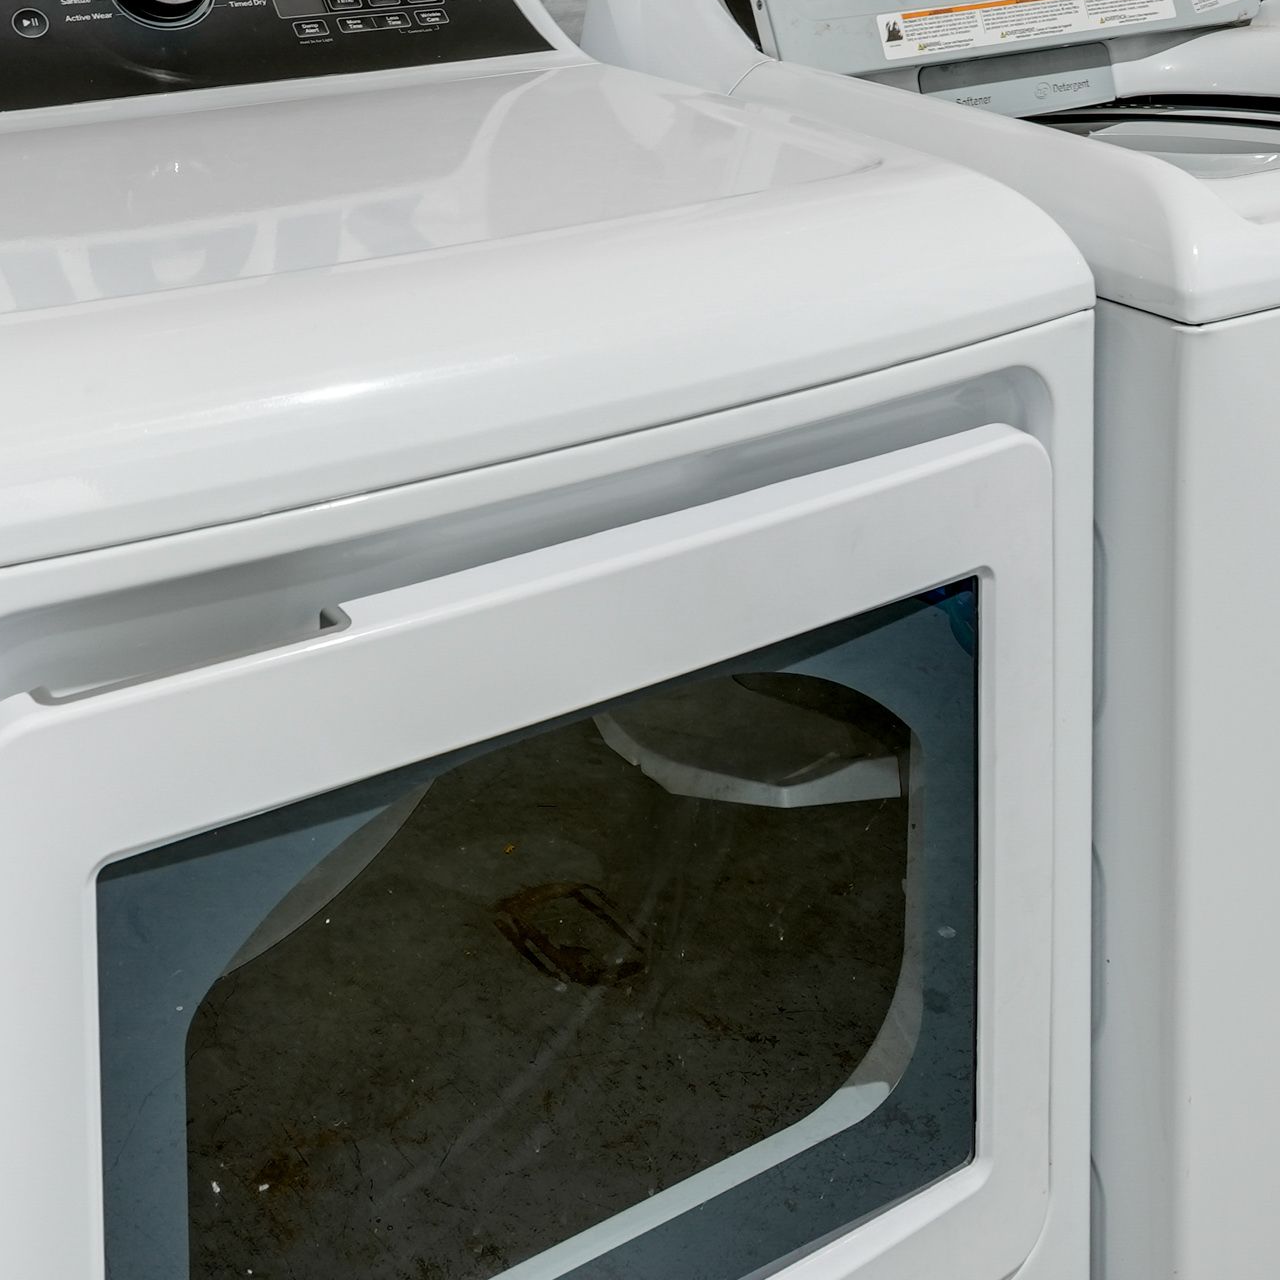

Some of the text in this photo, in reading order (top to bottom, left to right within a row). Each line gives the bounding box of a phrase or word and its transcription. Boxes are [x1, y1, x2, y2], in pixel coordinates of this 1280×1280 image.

[228, 0, 252, 8] Timed
[64, 12, 113, 23] Active Wear
[1052, 79, 1091, 93] Detergent
